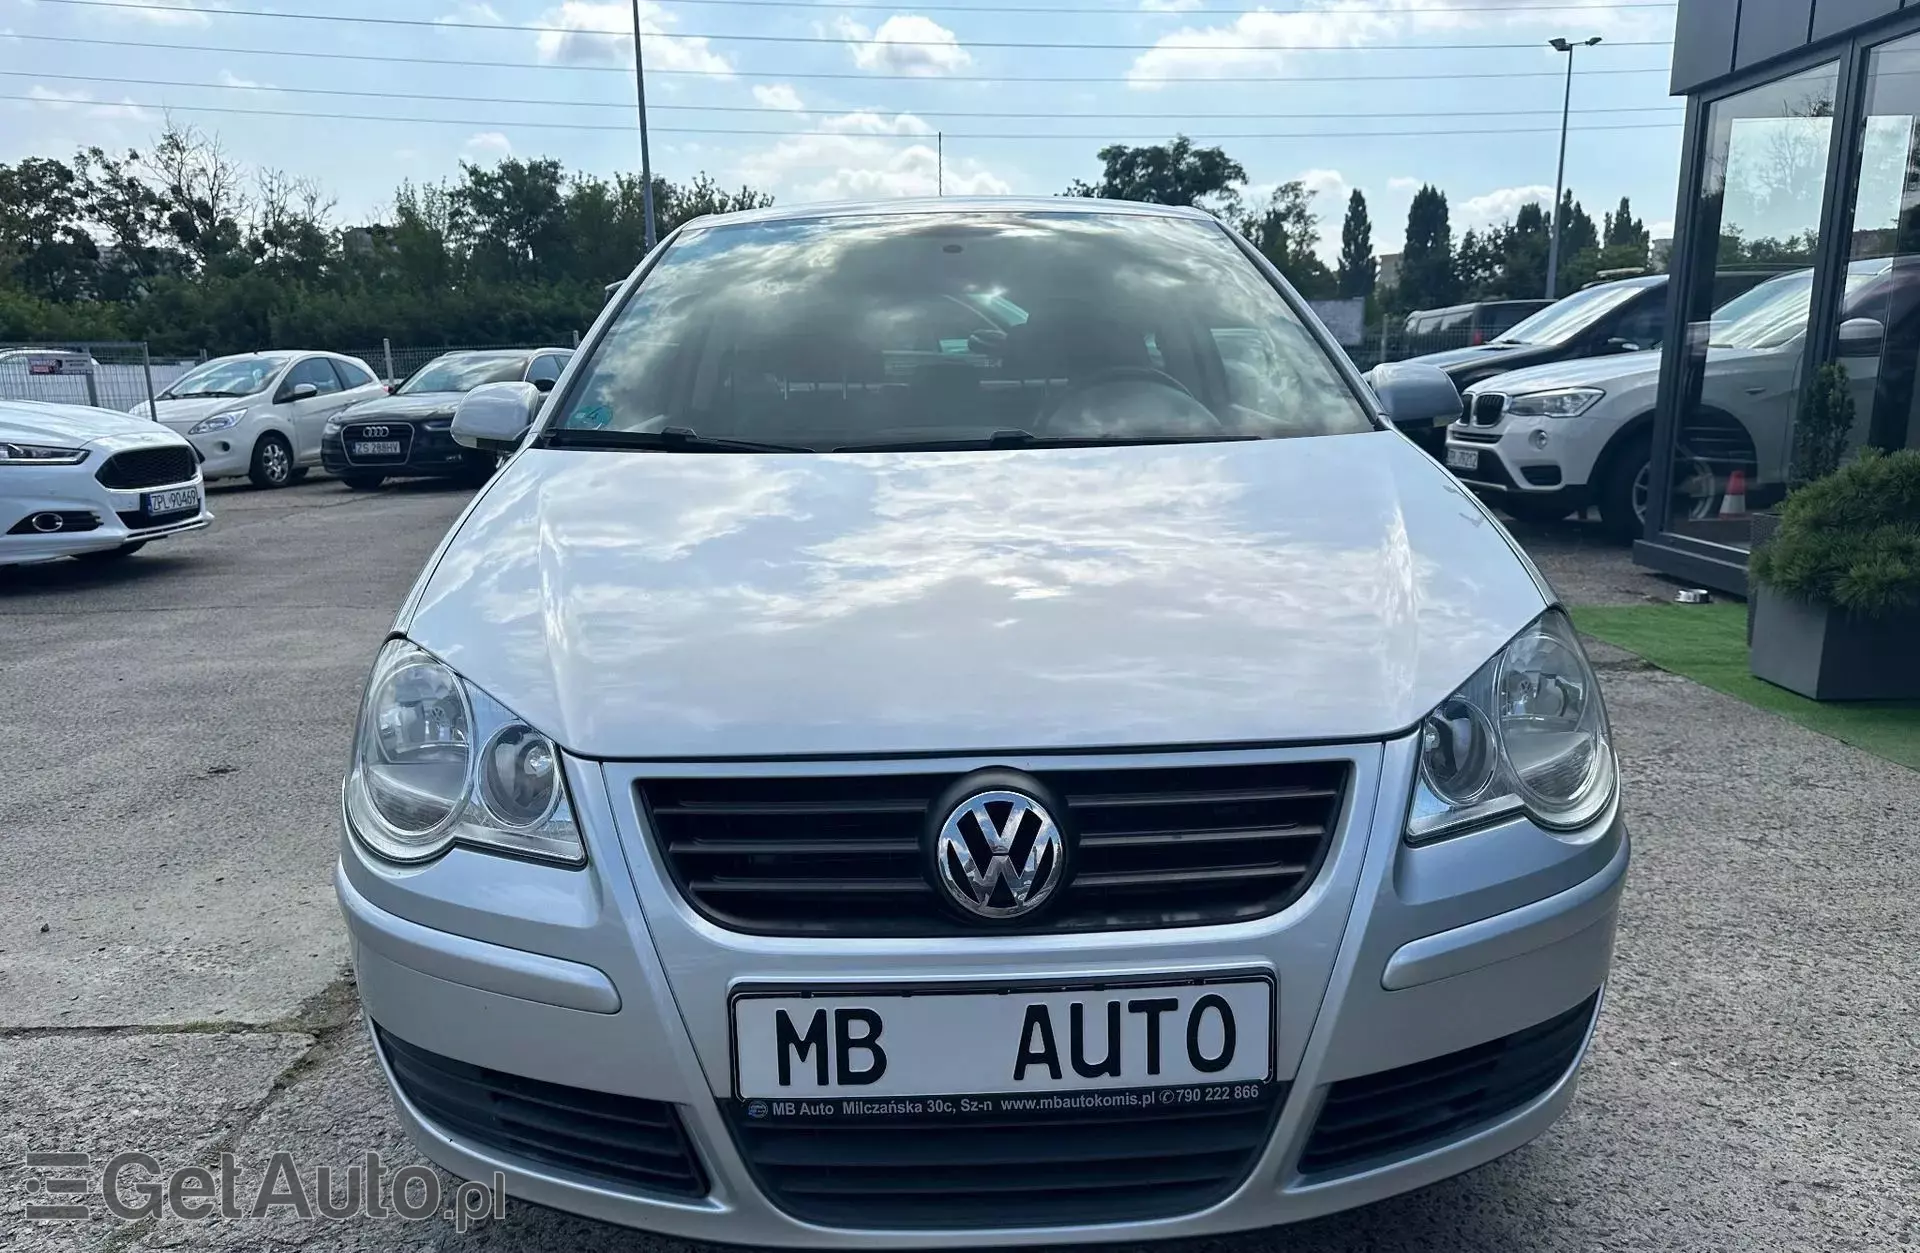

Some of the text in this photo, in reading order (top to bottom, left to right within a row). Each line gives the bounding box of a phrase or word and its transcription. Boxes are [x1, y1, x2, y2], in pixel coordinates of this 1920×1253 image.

[152, 490, 196, 510] ZPL 90469
[938, 791, 1063, 918] VW
[775, 992, 1237, 1087] MB AUTO
[772, 1102, 796, 1116] MB
[800, 1102, 835, 1116] Auto
[842, 1099, 923, 1116] Milczańska
[926, 1099, 957, 1114] 30c,
[960, 1098, 993, 1112] Sz-n
[1000, 1090, 1156, 1111] www.mbautokomis.pl
[1176, 1088, 1201, 1103] 790
[1204, 1086, 1230, 1101] 222
[1233, 1084, 1260, 1099] 866
